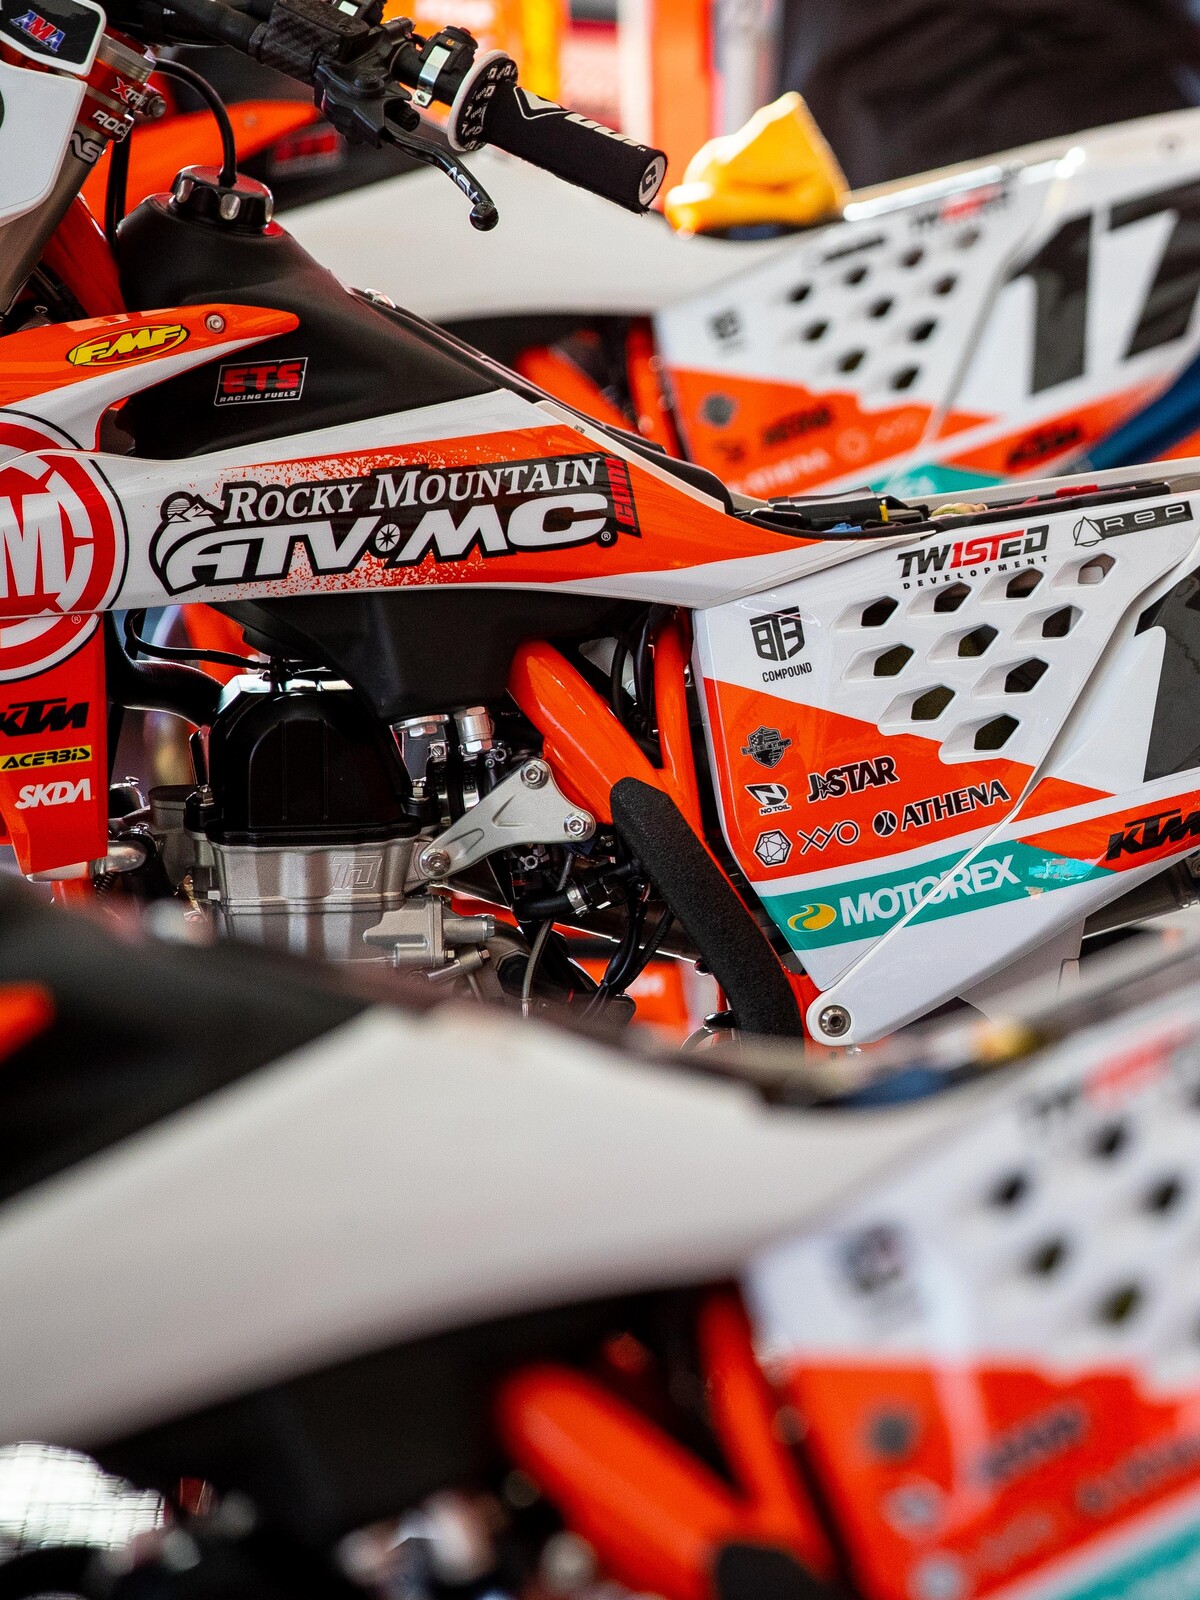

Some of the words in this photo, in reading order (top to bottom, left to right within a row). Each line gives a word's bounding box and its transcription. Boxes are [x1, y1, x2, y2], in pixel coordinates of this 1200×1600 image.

[10, 9, 65, 53] AMA
[73, 325, 182, 365] FMF
[223, 363, 301, 394] ETS
[219, 392, 262, 403] RACING
[264, 390, 297, 400] FUELS
[223, 482, 363, 524] ROCKY
[370, 457, 601, 509] MOUNTAIN
[903, 555, 1049, 590] DEVELOPMENT
[762, 661, 813, 683] COMPOUND
[2, 747, 91, 770] ACERBIS
[14, 778, 92, 810] SKDA
[902, 780, 1011, 831] ATHENA
[838, 854, 1022, 927] MOTOREX
